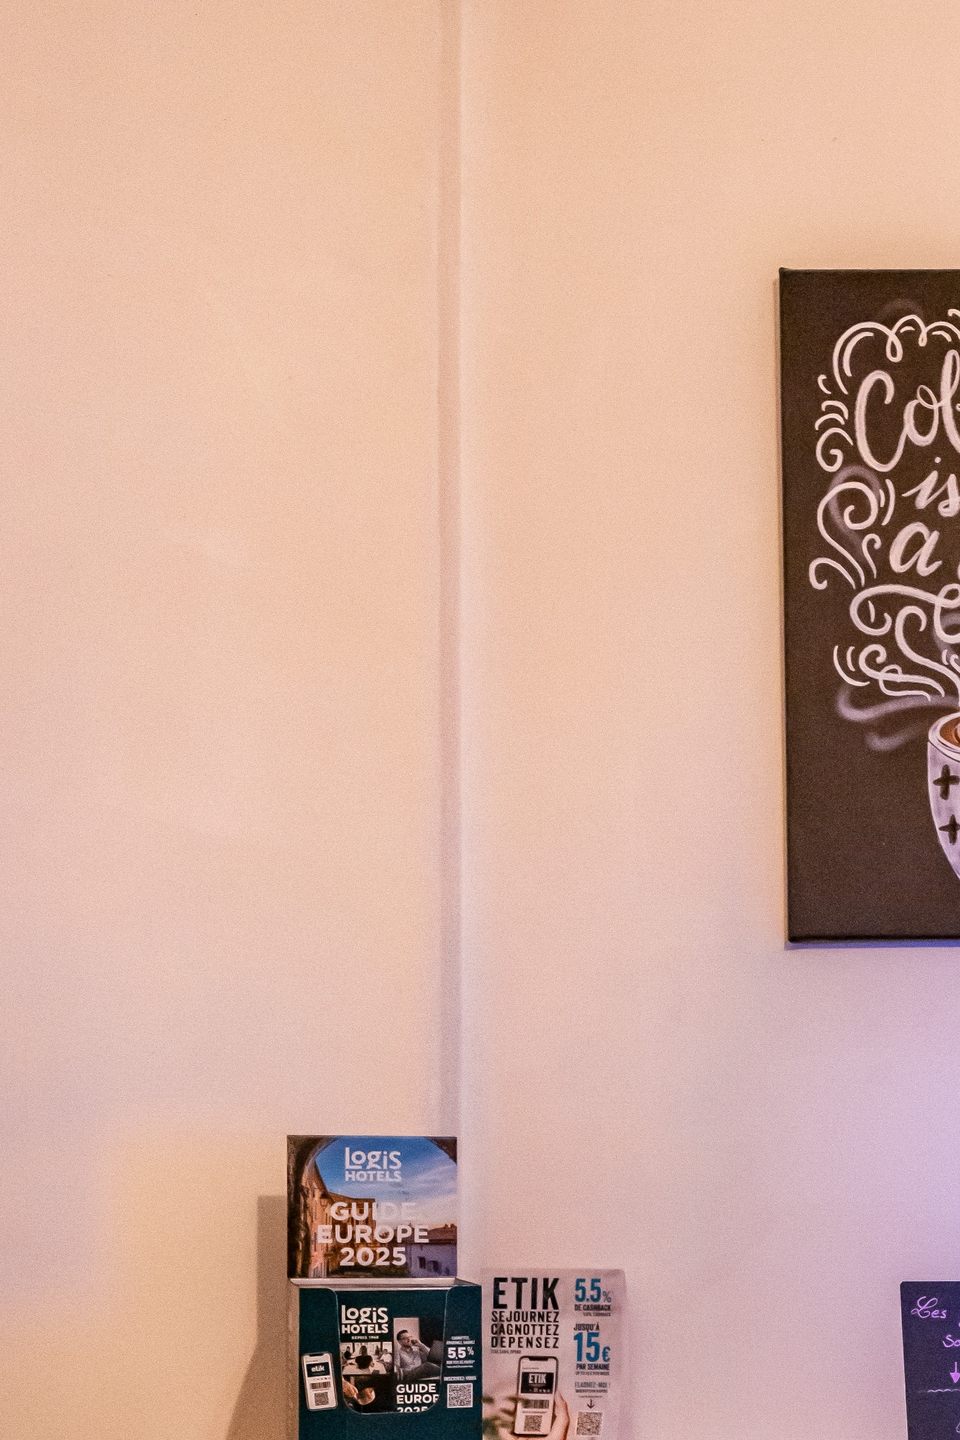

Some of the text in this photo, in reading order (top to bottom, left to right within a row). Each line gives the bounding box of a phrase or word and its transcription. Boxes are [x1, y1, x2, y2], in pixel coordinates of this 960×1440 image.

[890, 522, 942, 576] a
[345, 1170, 402, 1182] HOTELS
[330, 1202, 416, 1221] GUIDE
[316, 1225, 429, 1244] EUROPE
[339, 1247, 407, 1266] 2025
[493, 1277, 560, 1310] ETIK
[911, 1296, 948, 1319] Les
[491, 1311, 560, 1323] SEJOURNEZ
[341, 1324, 389, 1334] HOTELS
[491, 1323, 560, 1336] CAGNOTTEZ
[491, 1336, 560, 1349] DEPENSEZ
[528, 1374, 547, 1384] ETIK
[396, 1383, 437, 1393] GUIDE
